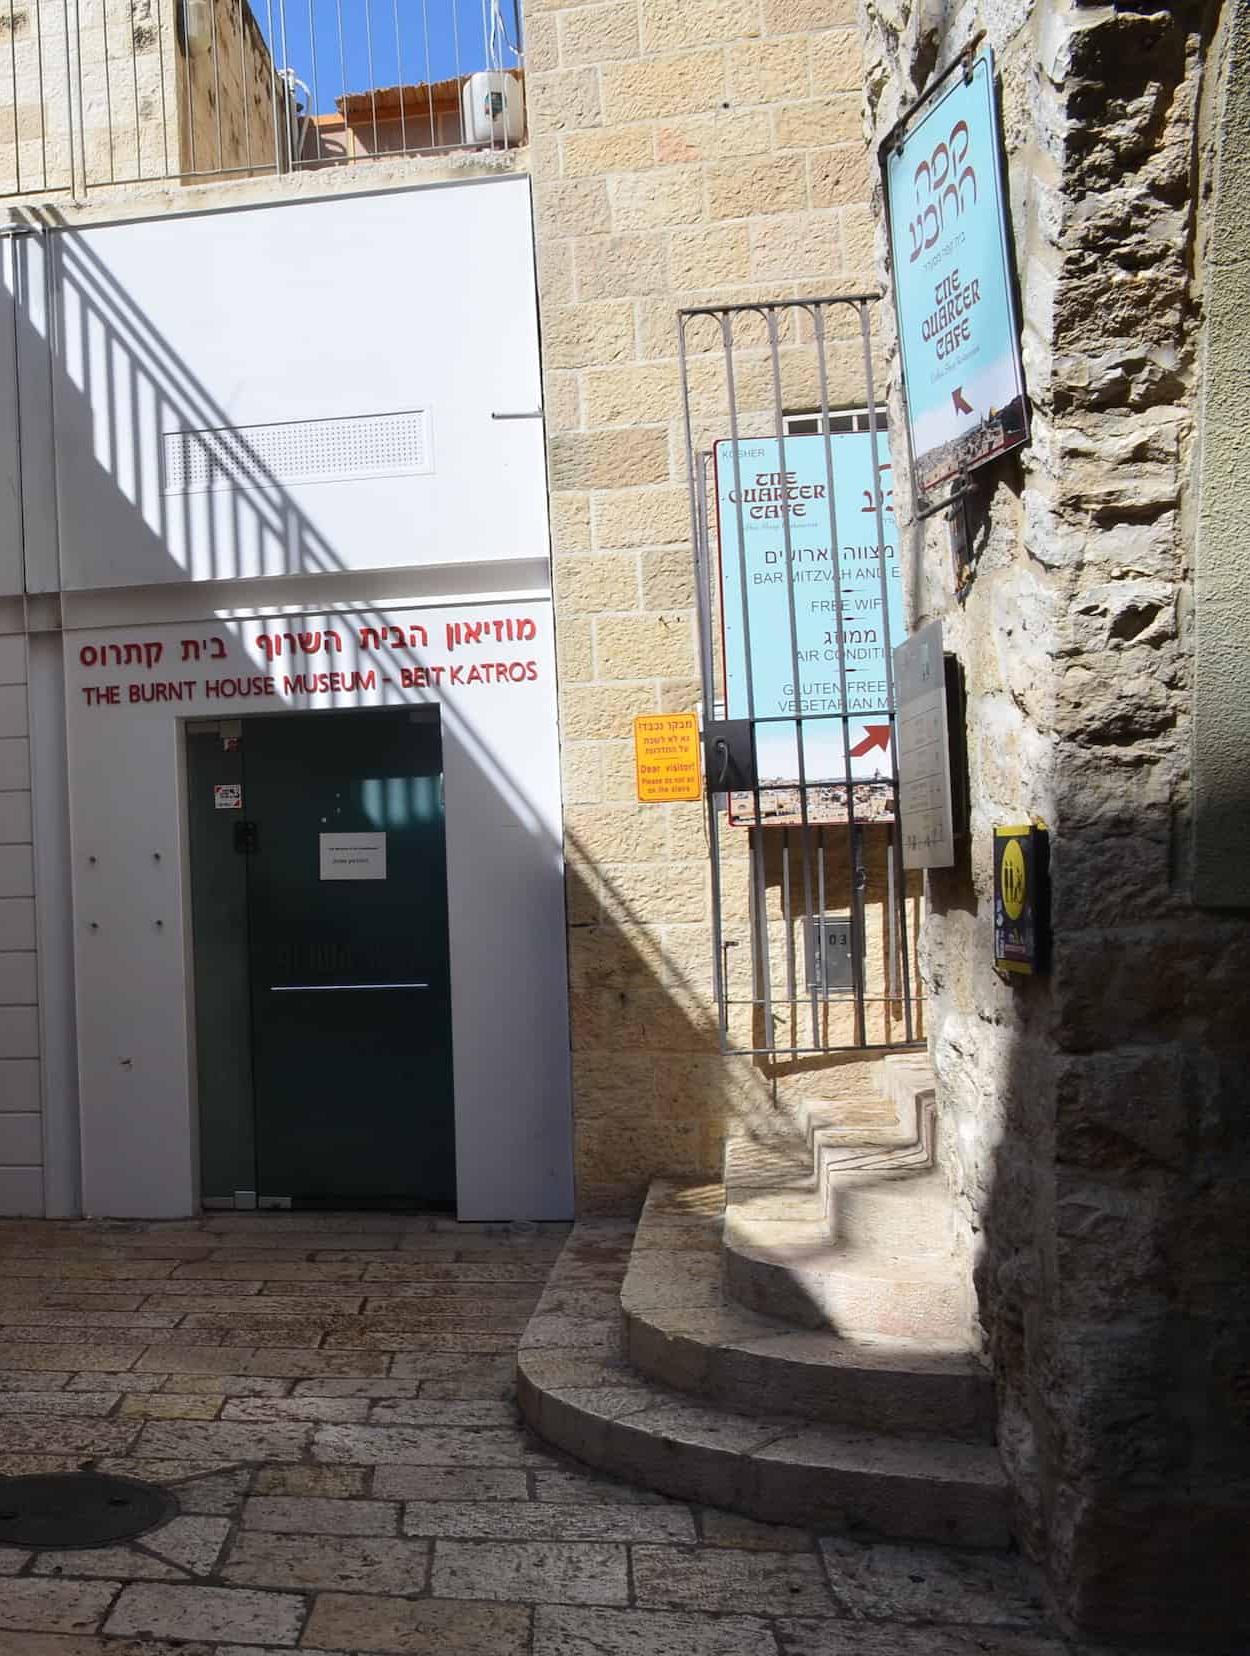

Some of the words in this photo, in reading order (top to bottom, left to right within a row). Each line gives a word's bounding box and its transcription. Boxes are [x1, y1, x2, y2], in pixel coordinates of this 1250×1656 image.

[914, 120, 968, 205] קפה
[909, 166, 976, 263] הרובע
[935, 268, 960, 306] THE
[921, 278, 981, 342] QUARTER
[935, 317, 971, 360] CAFE
[756, 472, 797, 486] THE
[729, 484, 826, 503] QUARTER
[750, 503, 806, 519] CAFE
[754, 572, 783, 584] BAR
[811, 600, 850, 612] FREE
[855, 599, 884, 611] WIF
[256, 629, 342, 663] השרוף
[359, 624, 428, 651] הבית
[446, 617, 537, 652] מוזיאון
[79, 642, 163, 669] קתרוס
[182, 637, 227, 661] בית
[797, 650, 819, 662] AIR
[824, 648, 893, 661] CONDITI
[82, 686, 120, 706] THE
[129, 681, 197, 704] BURNT
[206, 676, 275, 700] HOUSE
[284, 670, 376, 695] MUSEUM
[401, 666, 445, 688] BEIT
[451, 661, 538, 685] KATROS
[847, 681, 886, 693] FREE
